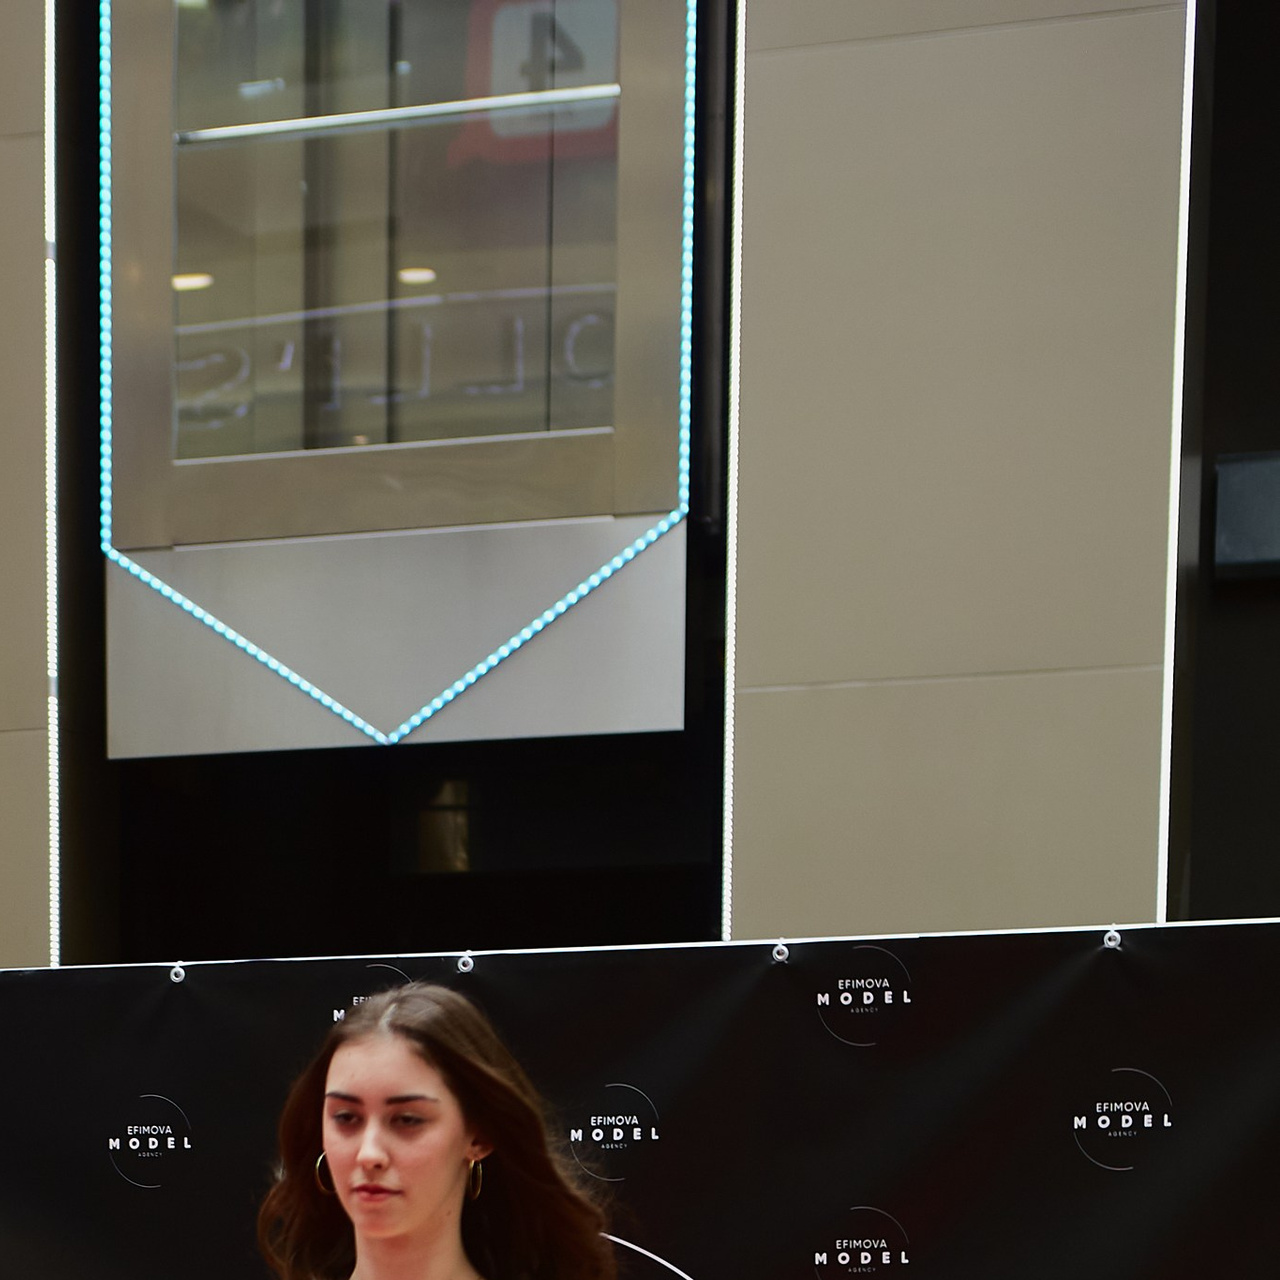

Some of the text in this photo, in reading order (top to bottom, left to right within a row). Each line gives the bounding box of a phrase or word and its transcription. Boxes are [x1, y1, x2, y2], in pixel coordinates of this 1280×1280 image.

[839, 979, 889, 989] EFIMOVA
[818, 991, 911, 1005] MODEL
[1096, 1102, 1149, 1112] EFIMOVA
[591, 1116, 638, 1126] EFIMOVA
[1074, 1114, 1171, 1129] MODEL
[128, 1126, 172, 1135] EFIMOVA
[571, 1128, 659, 1141] MODEL
[109, 1137, 191, 1149] MODEL
[836, 1239, 887, 1249] EFIMOVA
[815, 1251, 909, 1264] MODEL
